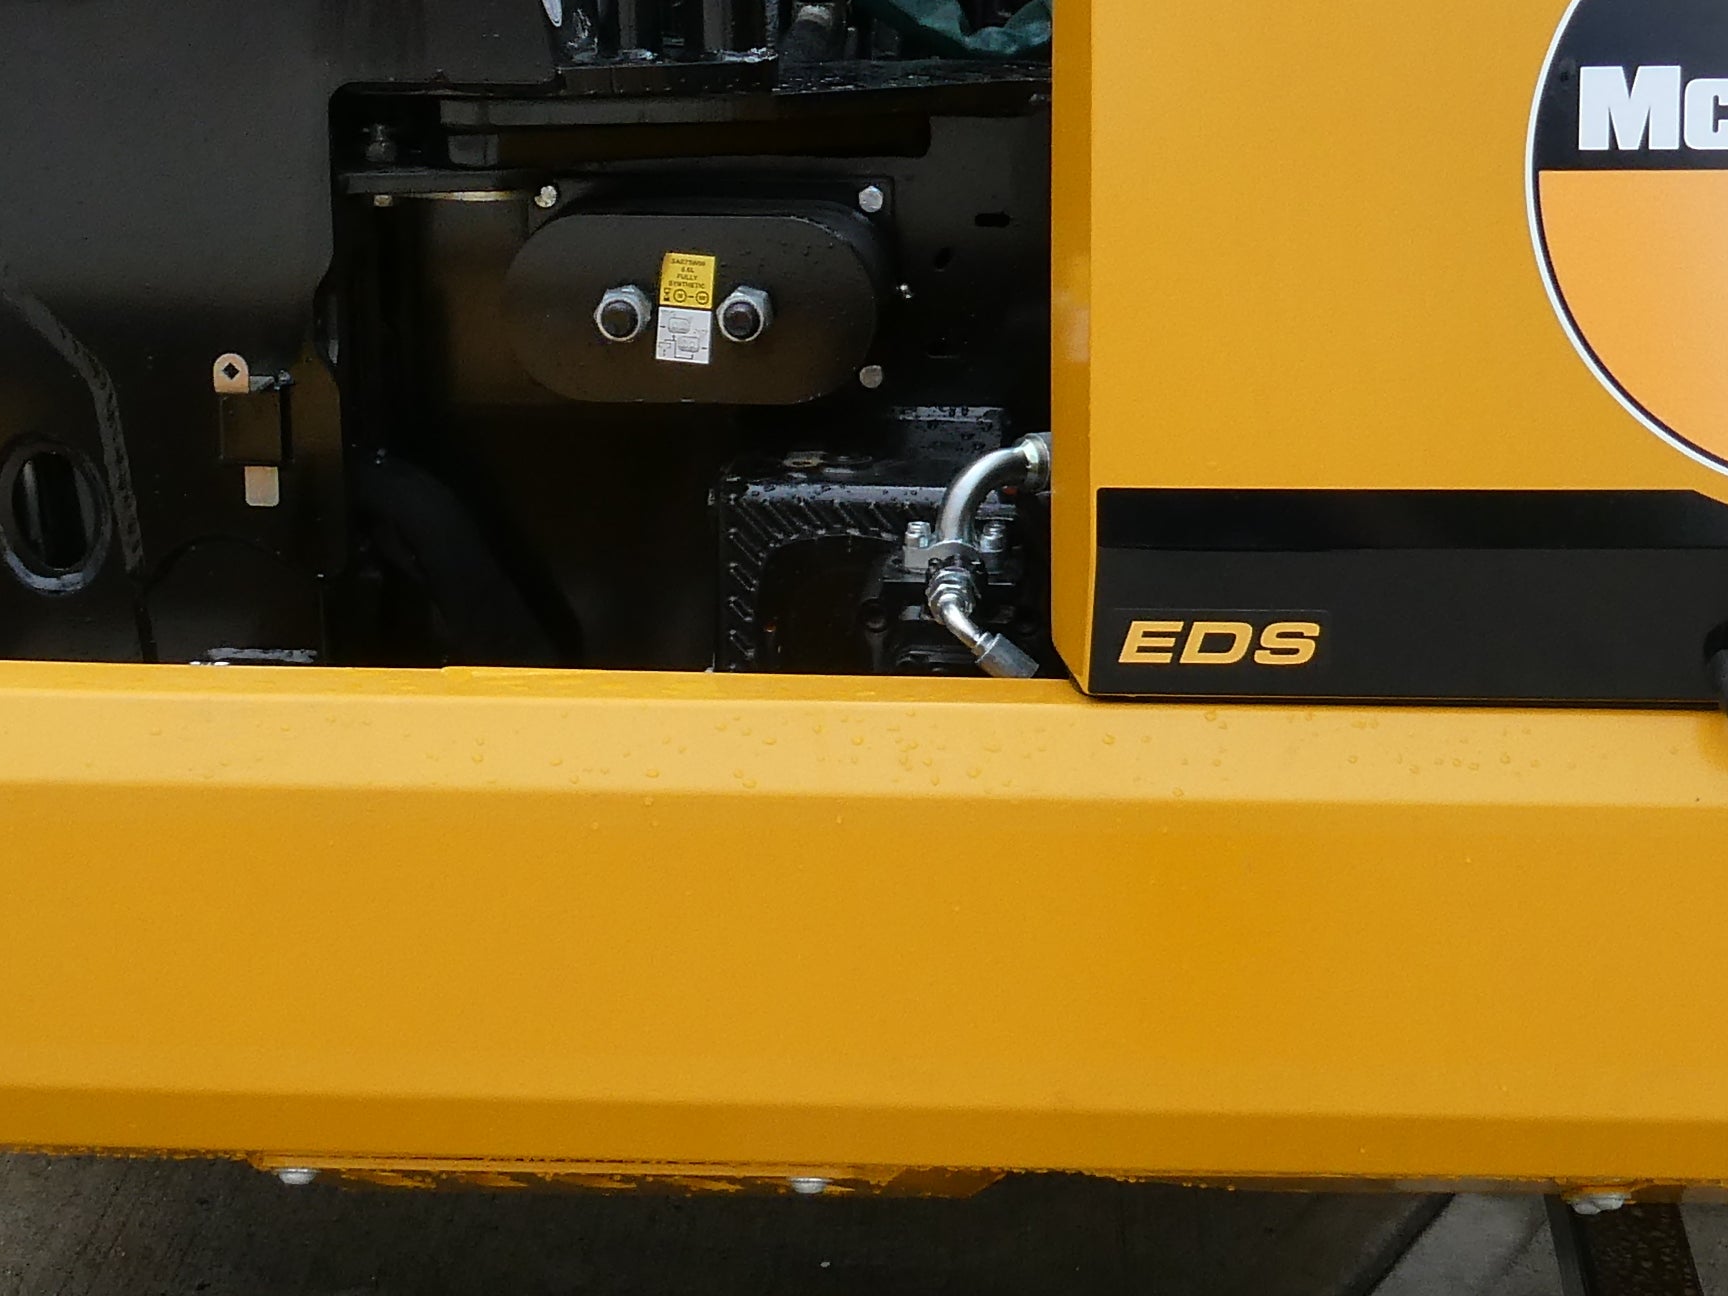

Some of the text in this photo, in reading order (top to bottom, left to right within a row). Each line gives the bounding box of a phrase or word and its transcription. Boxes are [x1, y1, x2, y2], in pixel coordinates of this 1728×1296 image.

[676, 273, 698, 281] FULLY
[668, 280, 705, 289] SYNTHETIC
[1119, 620, 1321, 665] EDS
